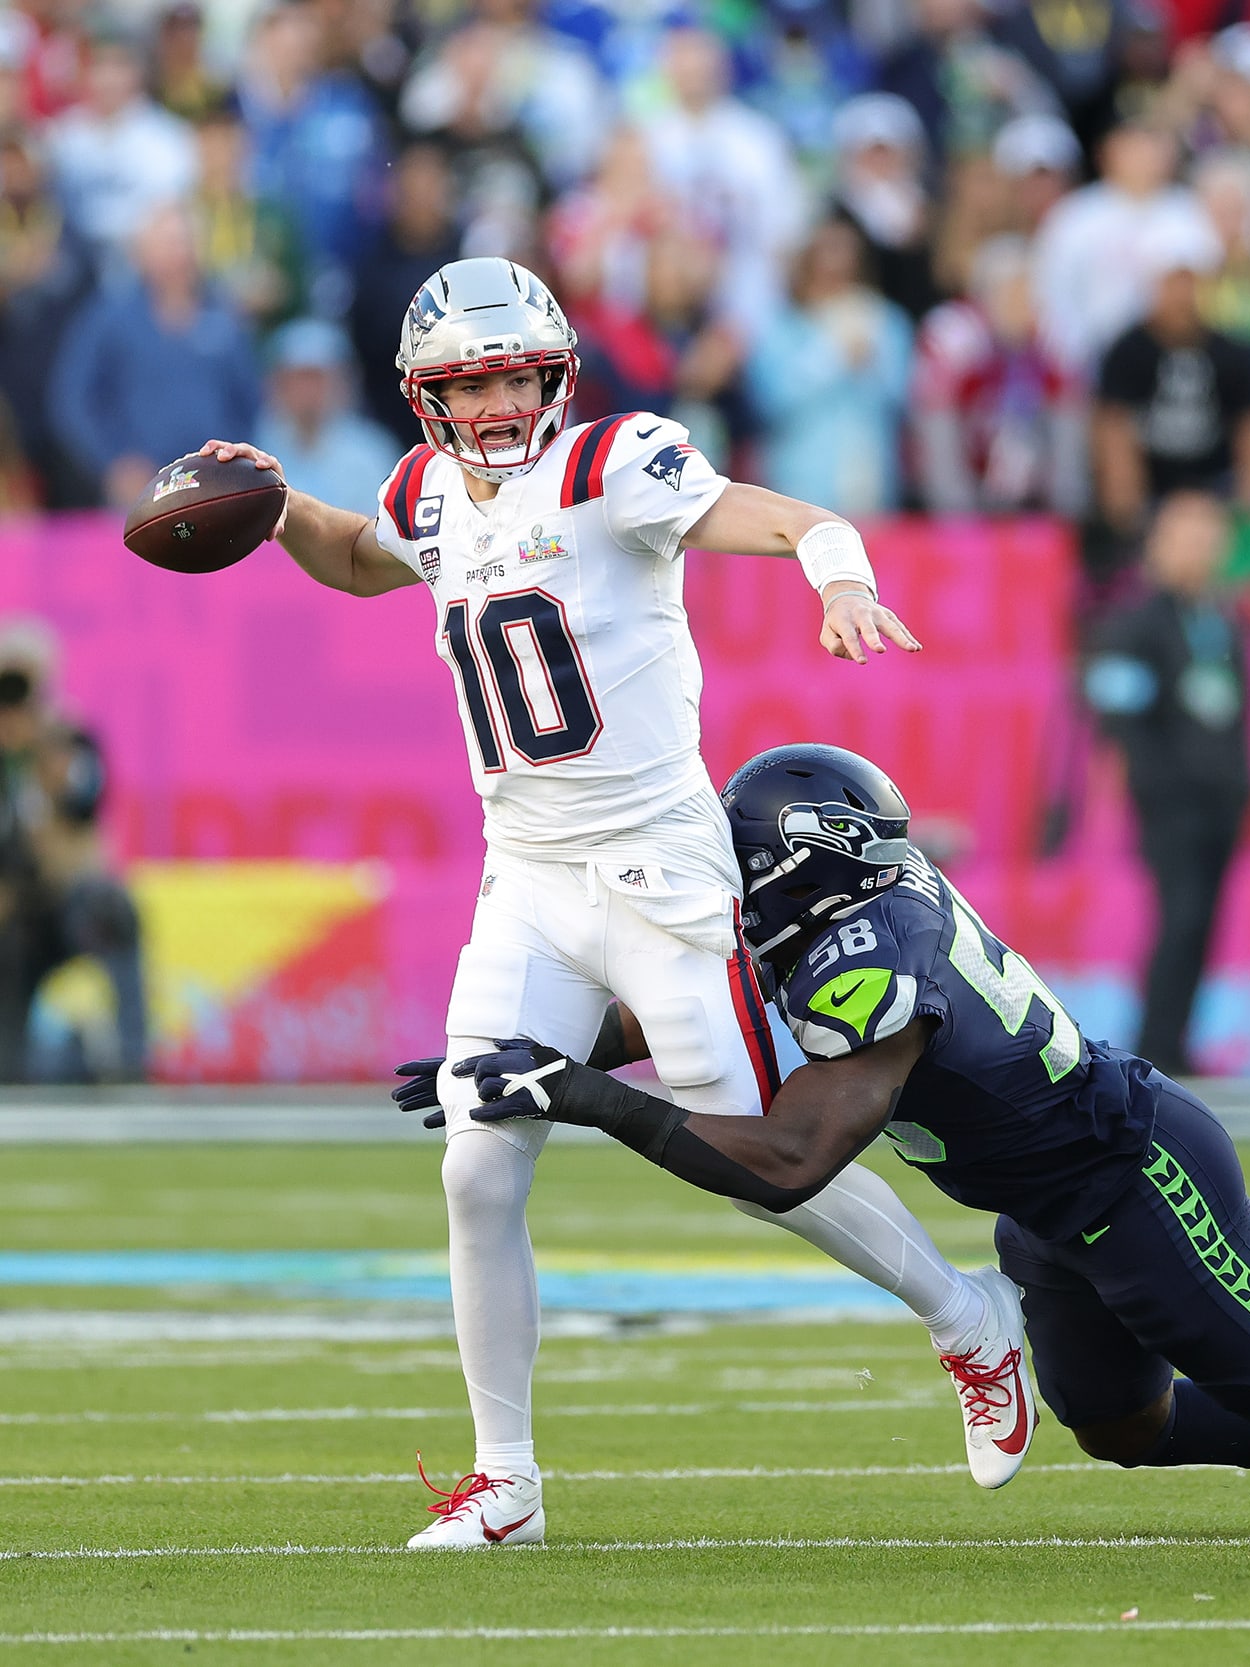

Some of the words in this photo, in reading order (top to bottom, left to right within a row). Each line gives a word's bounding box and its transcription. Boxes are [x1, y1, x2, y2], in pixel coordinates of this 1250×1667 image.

[415, 498, 441, 528] C
[420, 550, 439, 564] USA
[466, 564, 505, 584] PATRIOTS
[442, 586, 604, 774] 10
[859, 876, 875, 890] 45
[808, 918, 878, 978] 58
